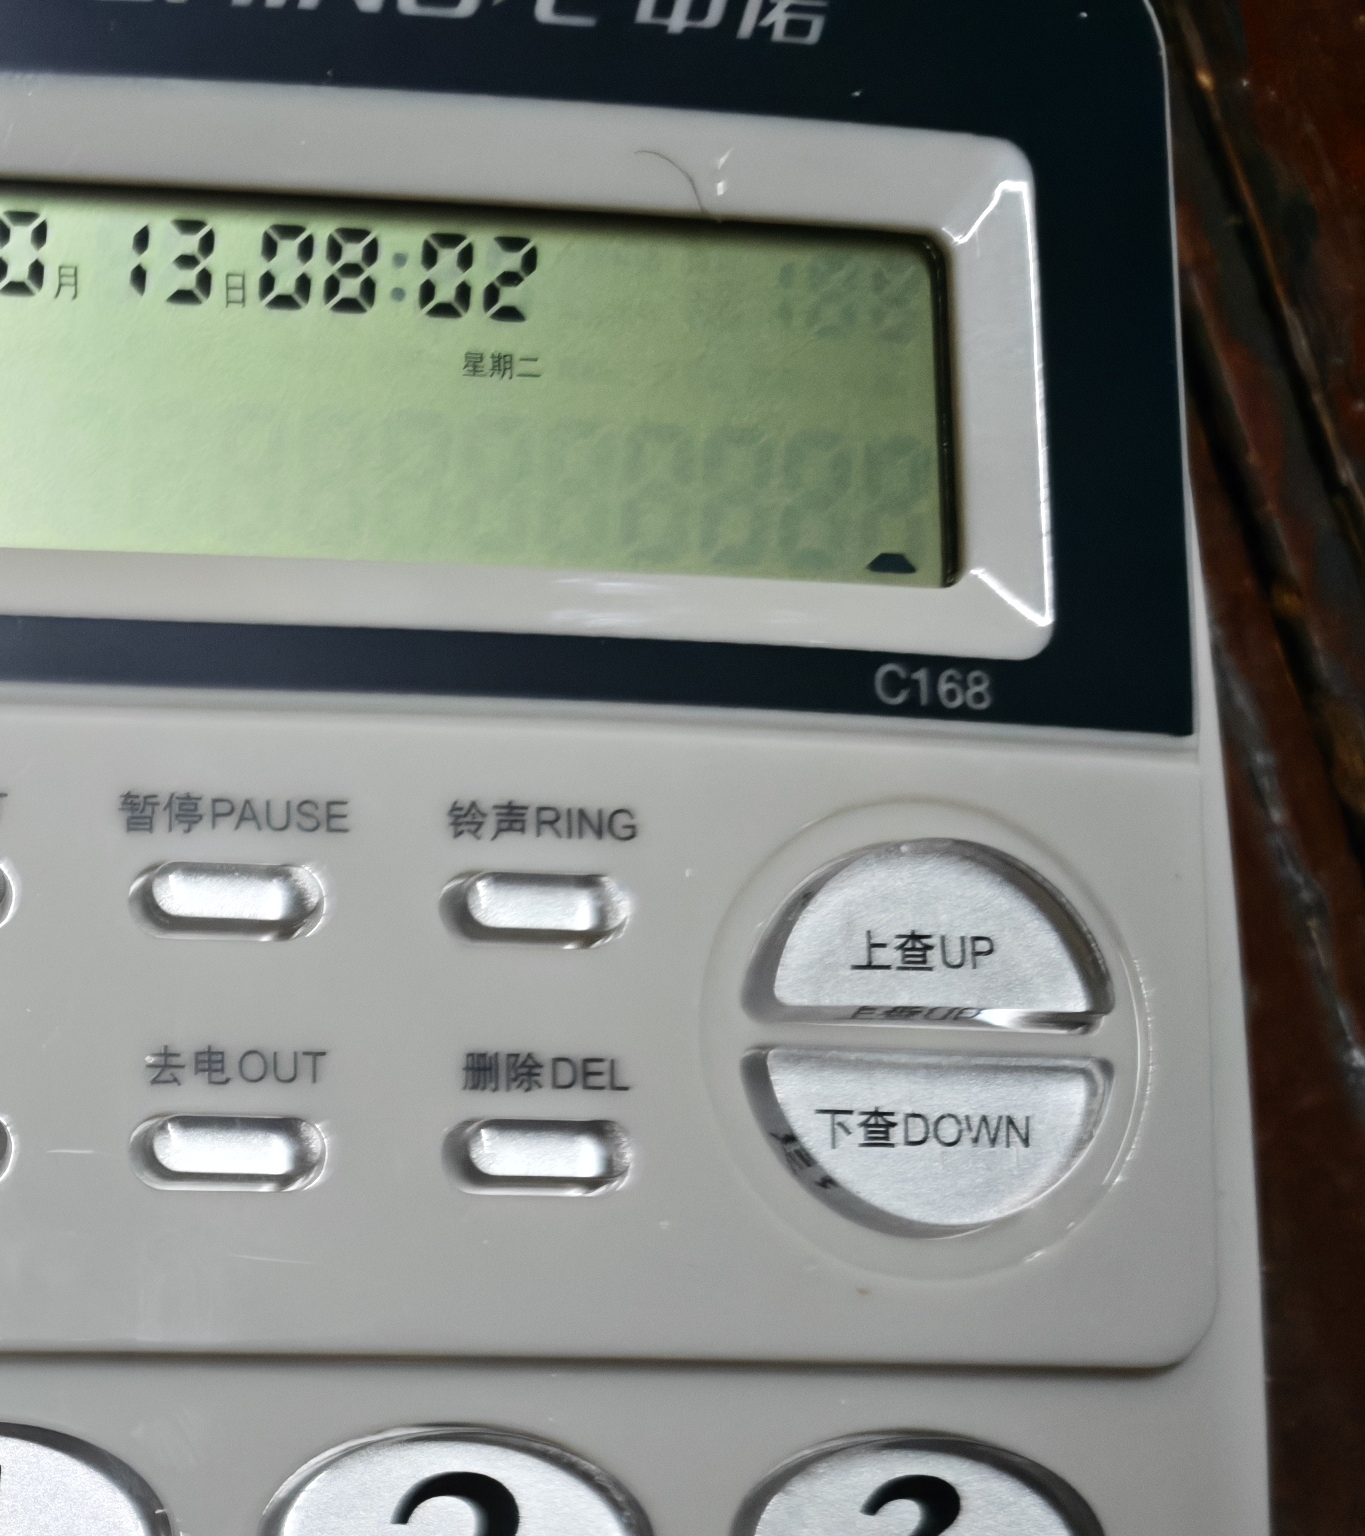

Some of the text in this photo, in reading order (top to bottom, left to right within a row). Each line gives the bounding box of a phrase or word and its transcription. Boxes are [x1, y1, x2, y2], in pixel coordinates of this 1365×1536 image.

[462, 350, 543, 380] 星期二
[874, 662, 993, 711] C168
[118, 790, 351, 835] 暂停PAUSE
[446, 800, 639, 843] 铃声RING
[850, 929, 996, 973] 上查UP
[144, 1044, 328, 1087] 去电OUT
[462, 1051, 631, 1093] 删除DEL
[815, 1107, 1032, 1150] 下查DOWN
